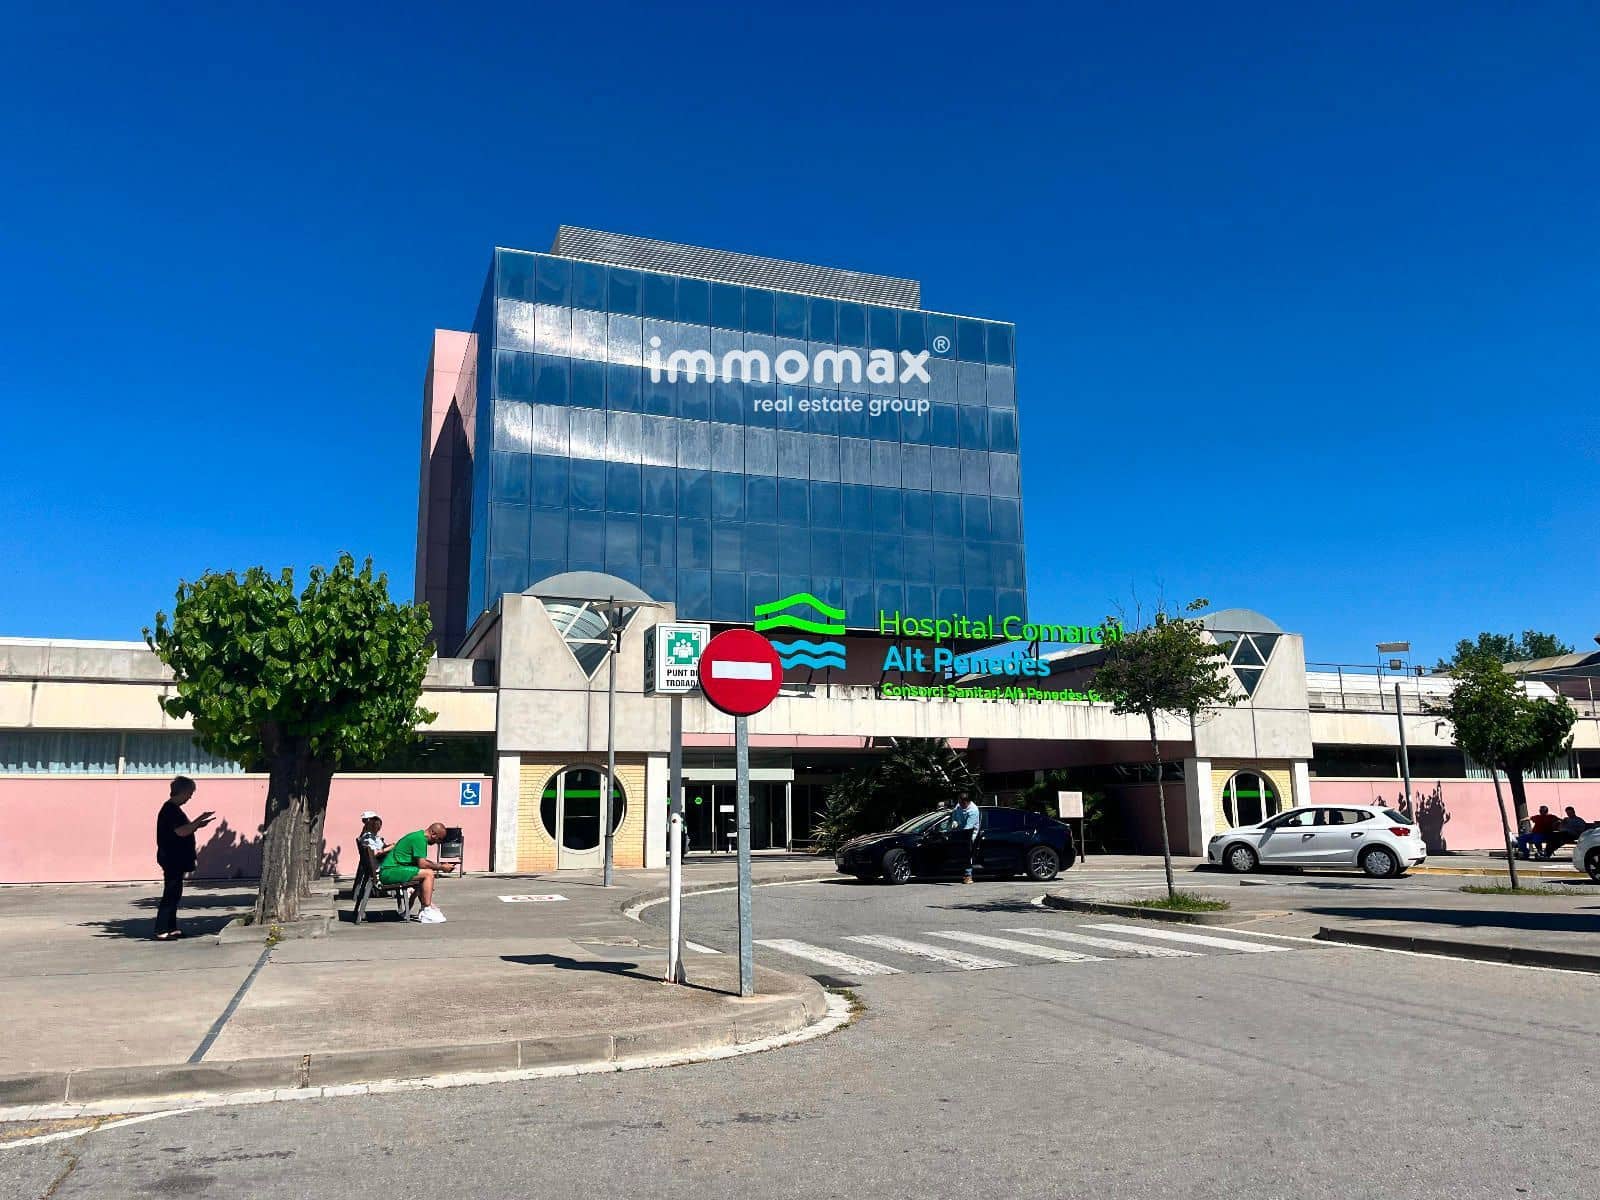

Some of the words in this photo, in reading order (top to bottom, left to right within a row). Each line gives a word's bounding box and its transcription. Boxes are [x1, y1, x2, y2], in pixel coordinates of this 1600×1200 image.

[879, 609, 993, 644] Hospital
[1003, 615, 1123, 644] Comarcal
[882, 645, 927, 673] Alt
[934, 647, 1051, 676] Penedès
[882, 682, 943, 698] Consorci
[947, 684, 1001, 699] Sanitari
[1004, 686, 1024, 701] Alt
